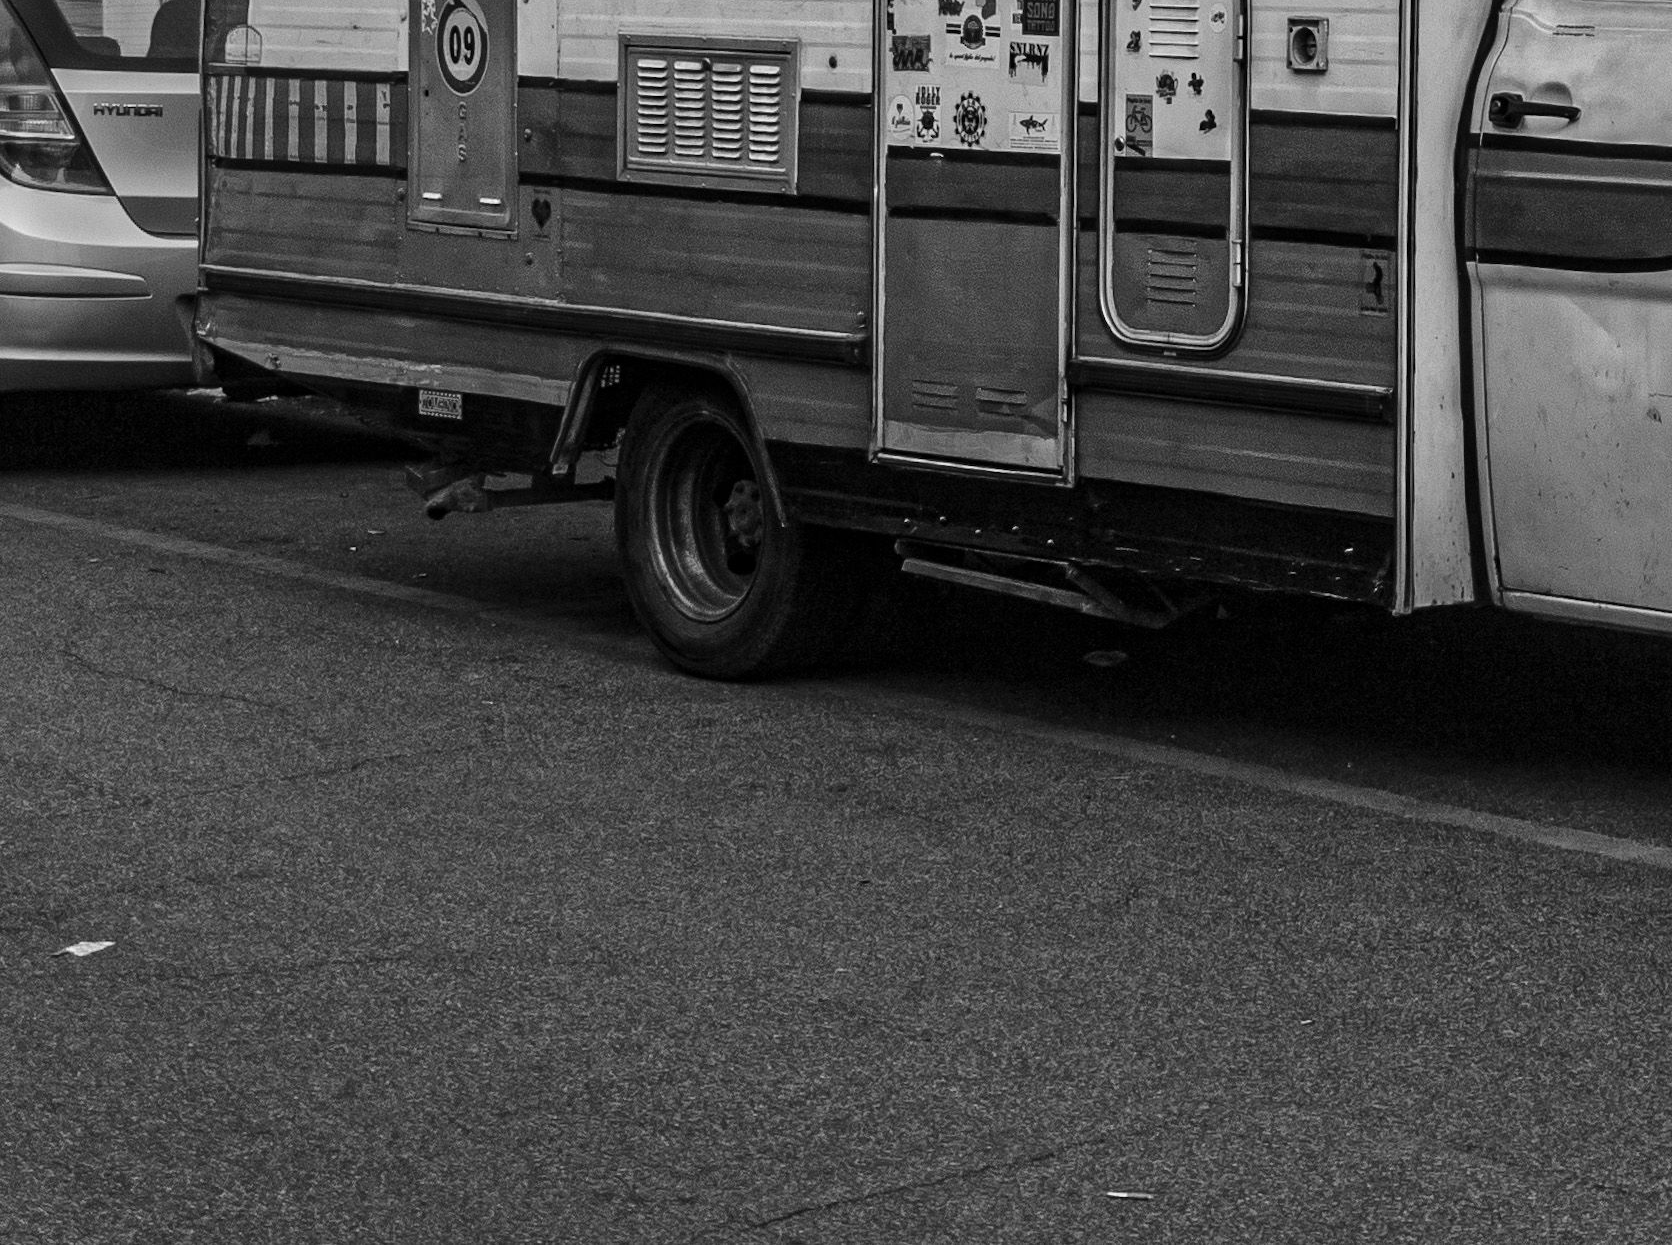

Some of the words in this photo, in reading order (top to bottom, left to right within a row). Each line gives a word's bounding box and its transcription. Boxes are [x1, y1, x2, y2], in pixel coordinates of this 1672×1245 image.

[1027, 2, 1056, 19] SONG
[449, 25, 476, 66] 09
[916, 86, 941, 95] JOLLY
[915, 93, 940, 105] ROGER
[93, 102, 163, 117] HYUNDAI
[457, 101, 467, 162] GAS
